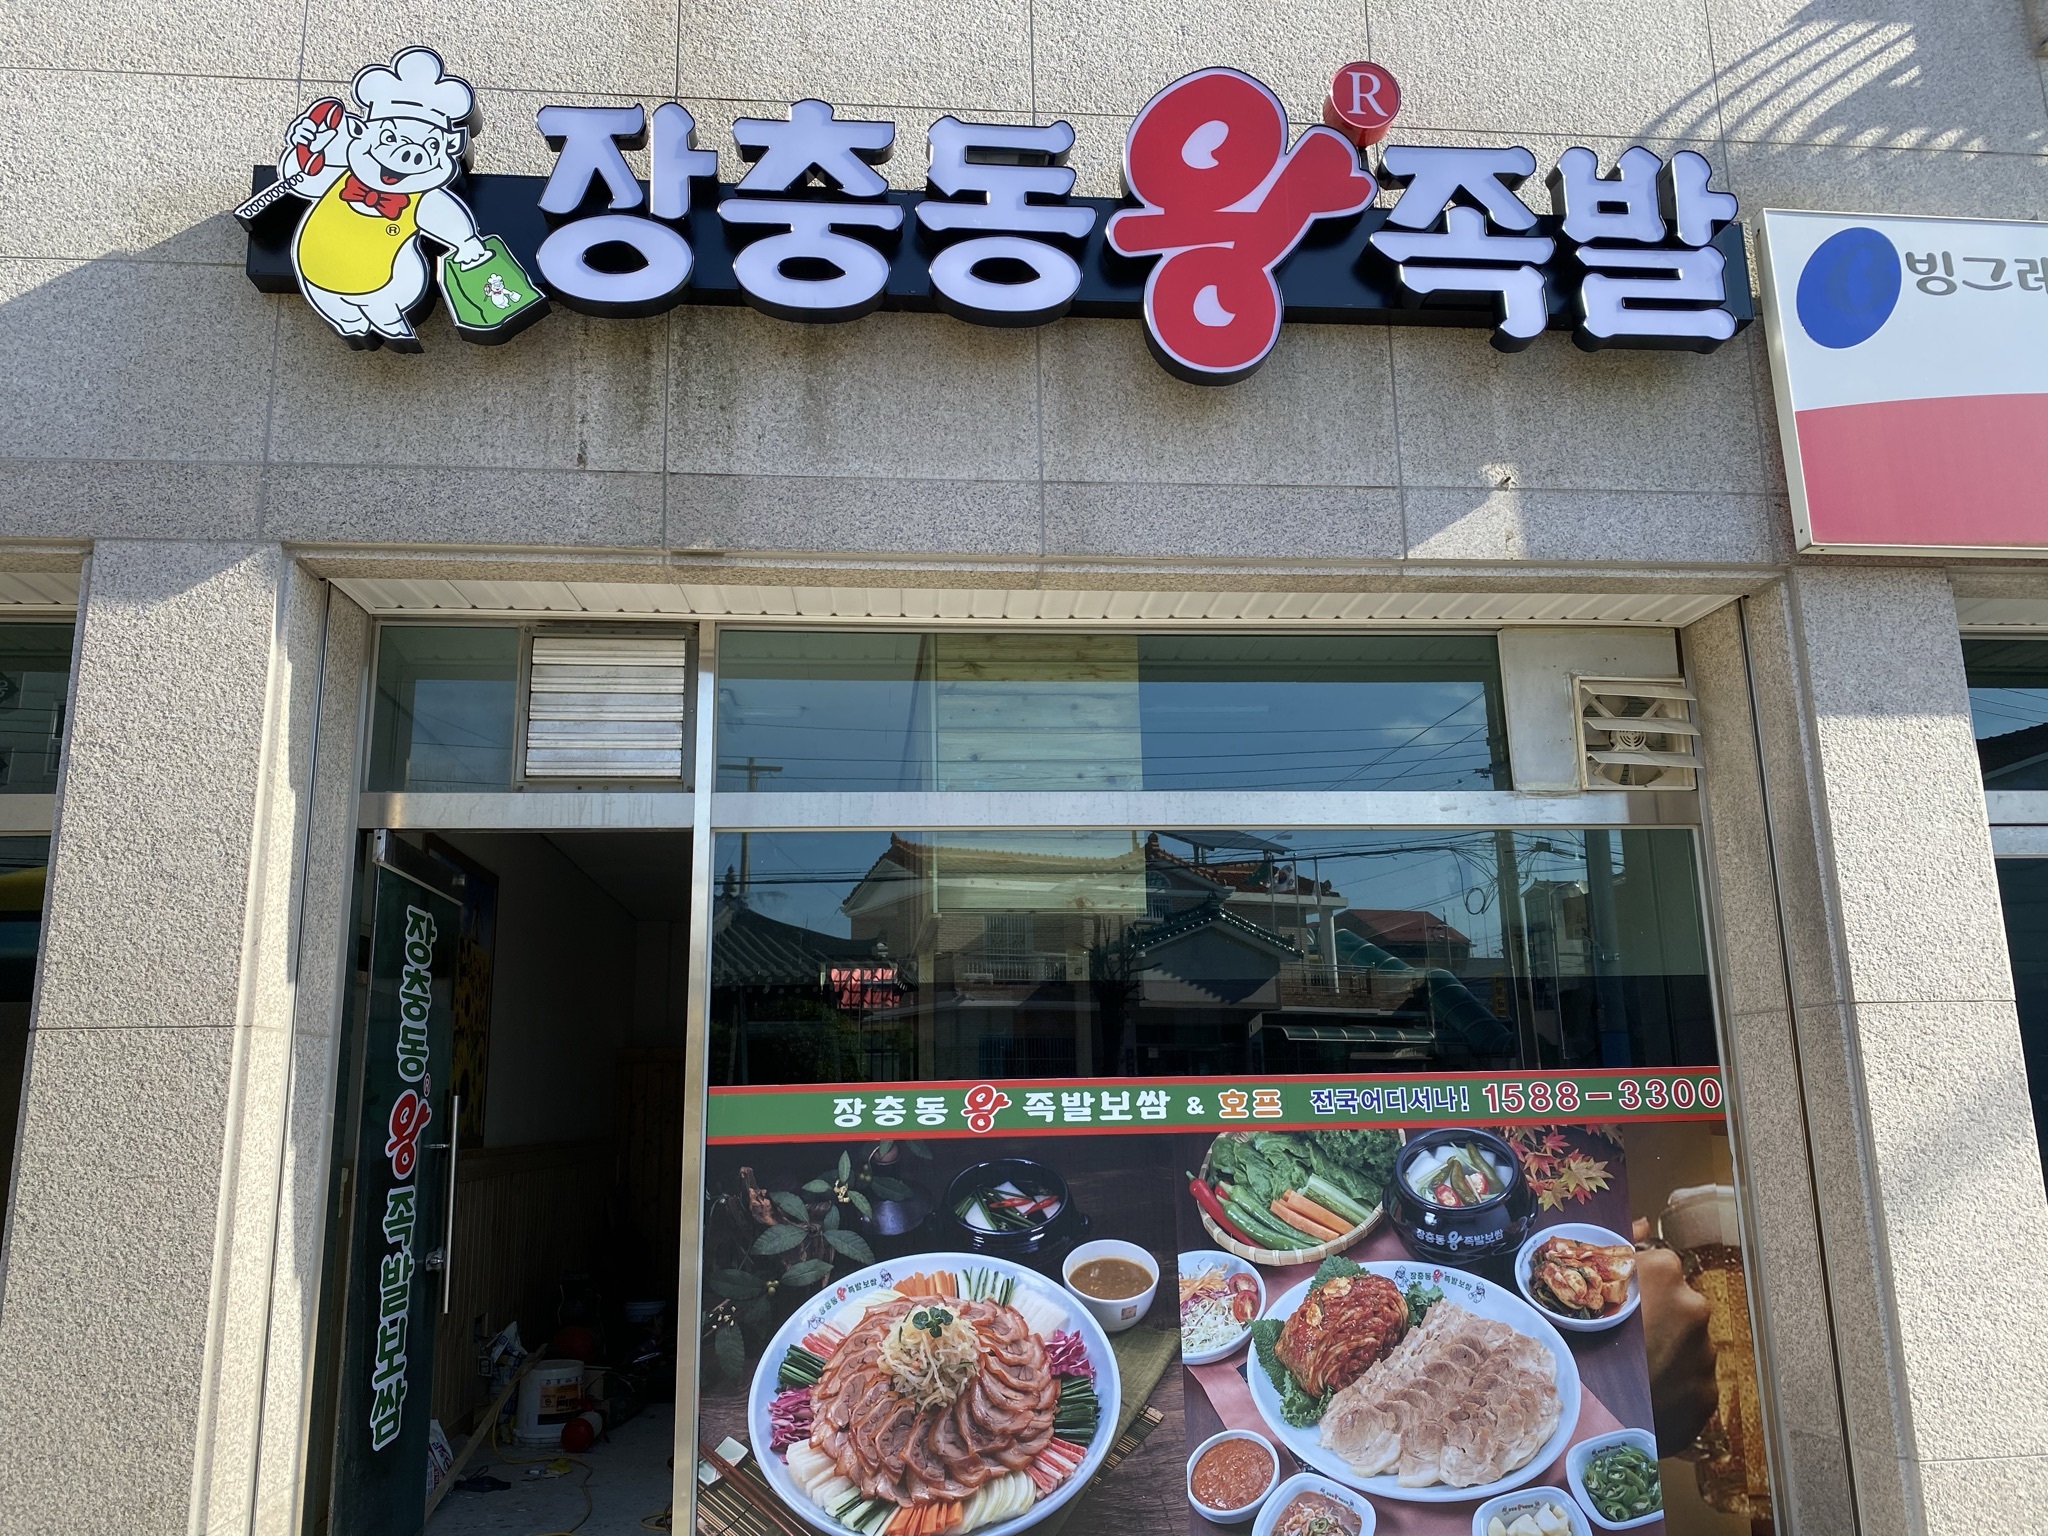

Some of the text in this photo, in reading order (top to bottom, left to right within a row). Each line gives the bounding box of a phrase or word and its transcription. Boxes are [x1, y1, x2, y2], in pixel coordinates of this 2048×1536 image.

[536, 66, 1739, 372] 장충동 왕 족발
[833, 1078, 1722, 1133] 장충동 왕 족발보쌈 & 호프 전국어디서나! 1588-3300
